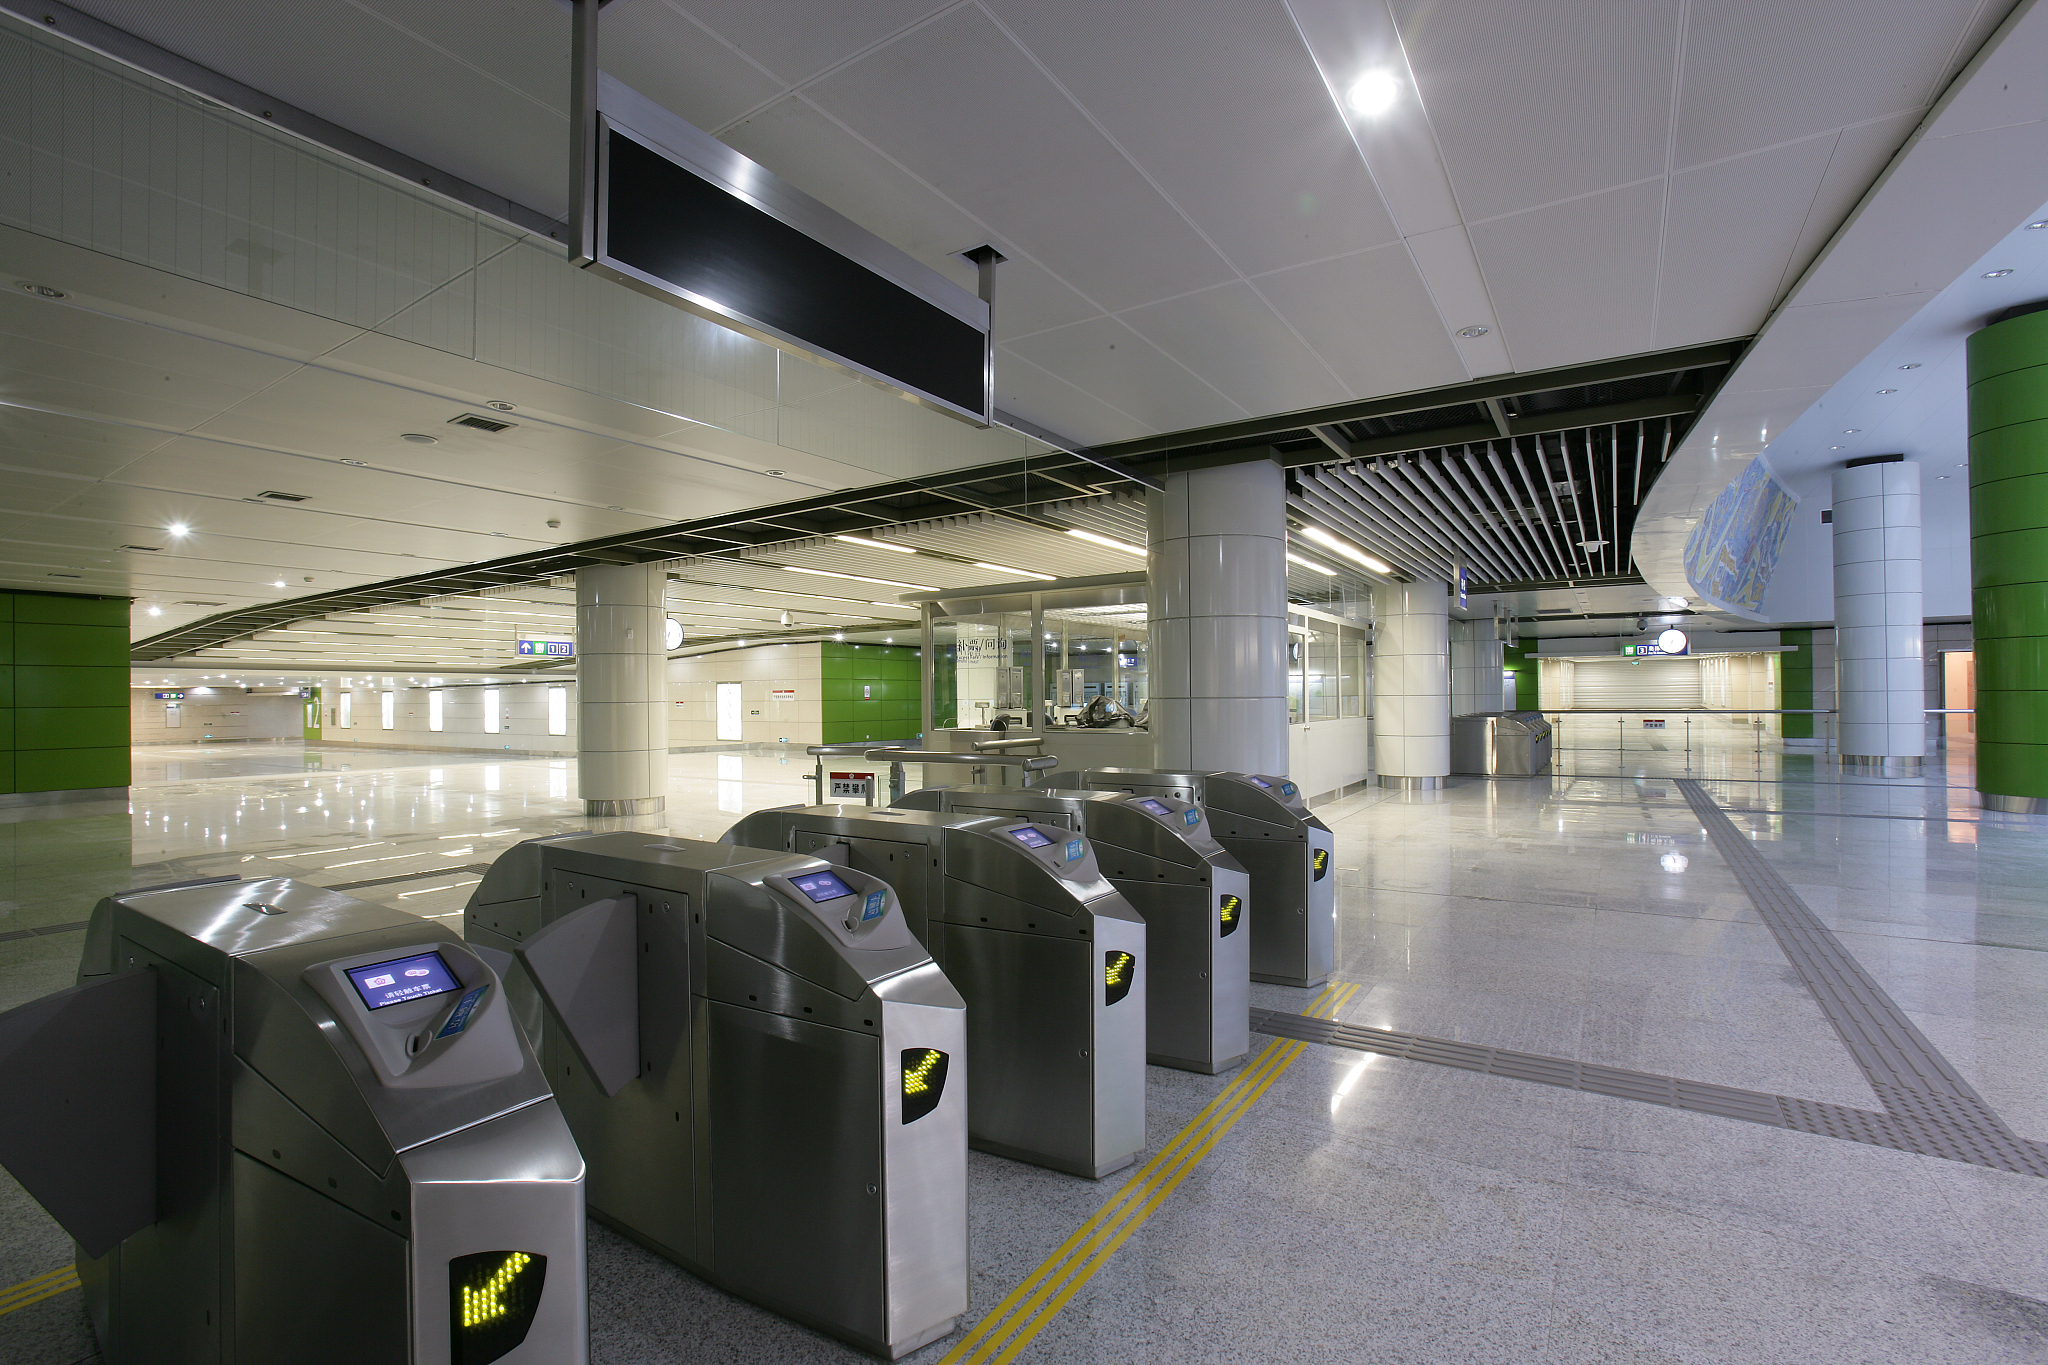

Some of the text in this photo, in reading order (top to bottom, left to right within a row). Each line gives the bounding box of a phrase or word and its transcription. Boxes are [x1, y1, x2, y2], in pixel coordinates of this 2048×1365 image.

[379, 987, 443, 1006] Please Touch Ticket
